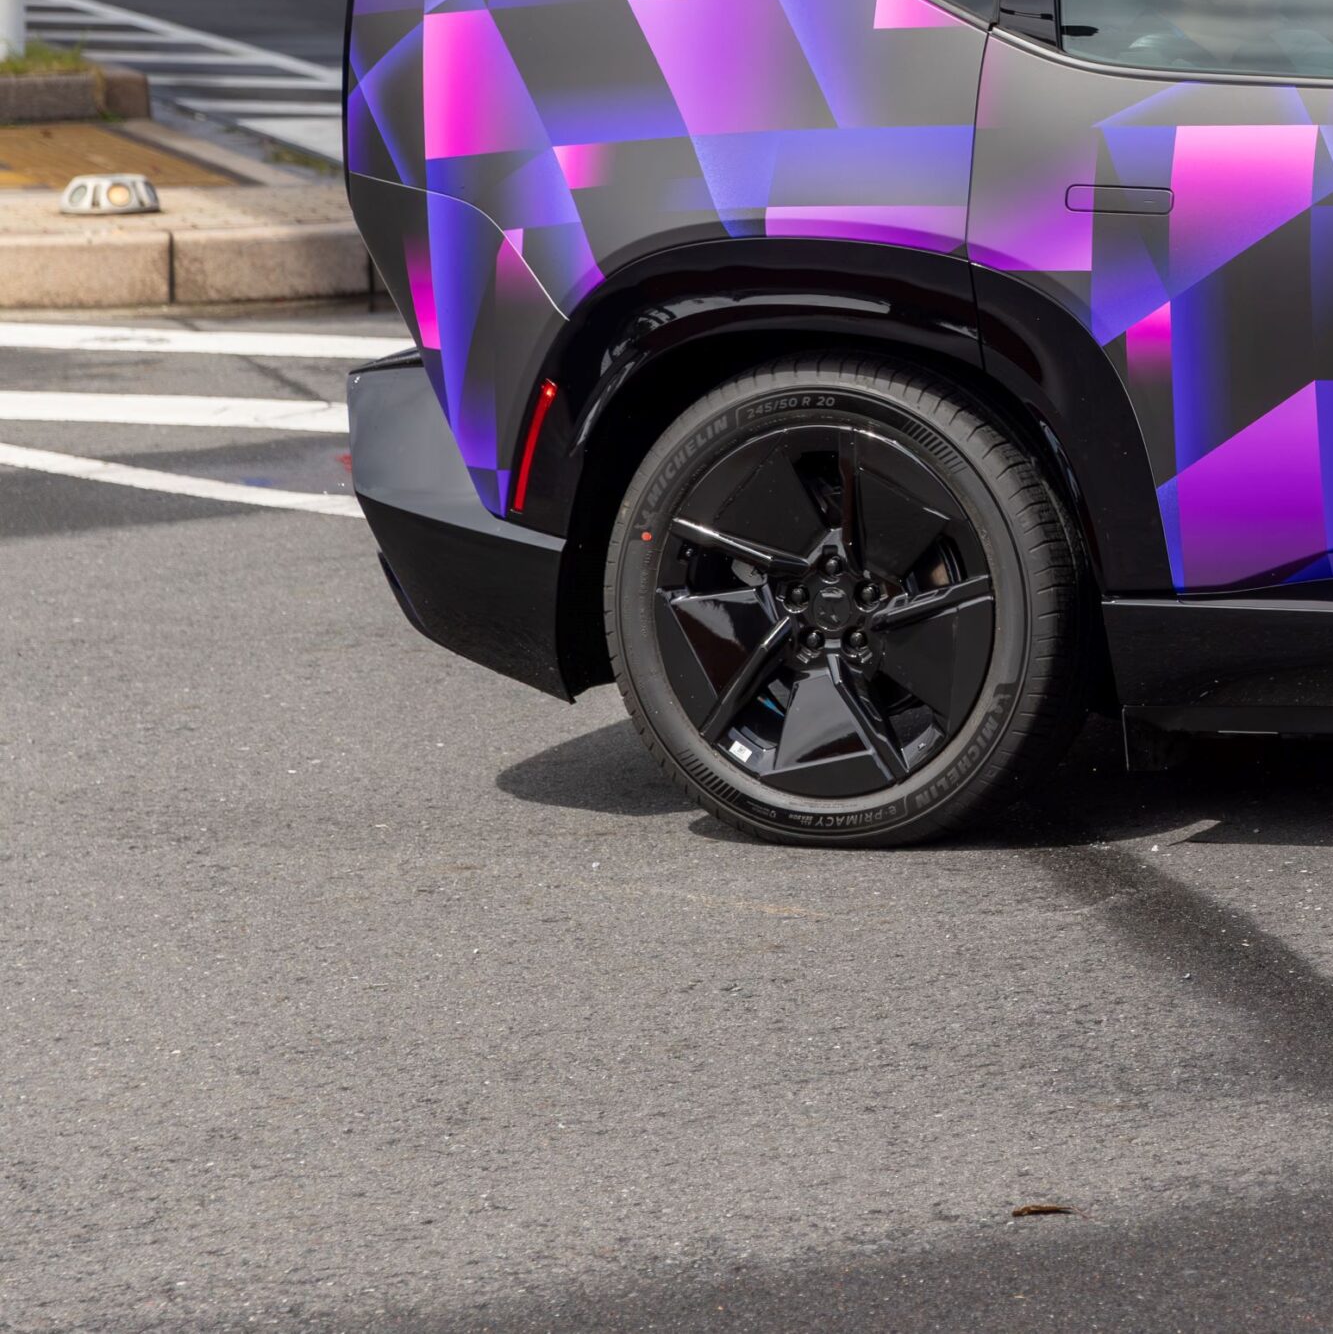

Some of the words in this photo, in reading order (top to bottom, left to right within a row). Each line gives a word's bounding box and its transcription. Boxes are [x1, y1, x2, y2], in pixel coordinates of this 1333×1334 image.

[746, 397, 798, 419] 245/50
[802, 396, 811, 407] R
[817, 396, 836, 407] 20
[647, 416, 729, 507] MICHELIN
[914, 717, 999, 807] MICHELIN
